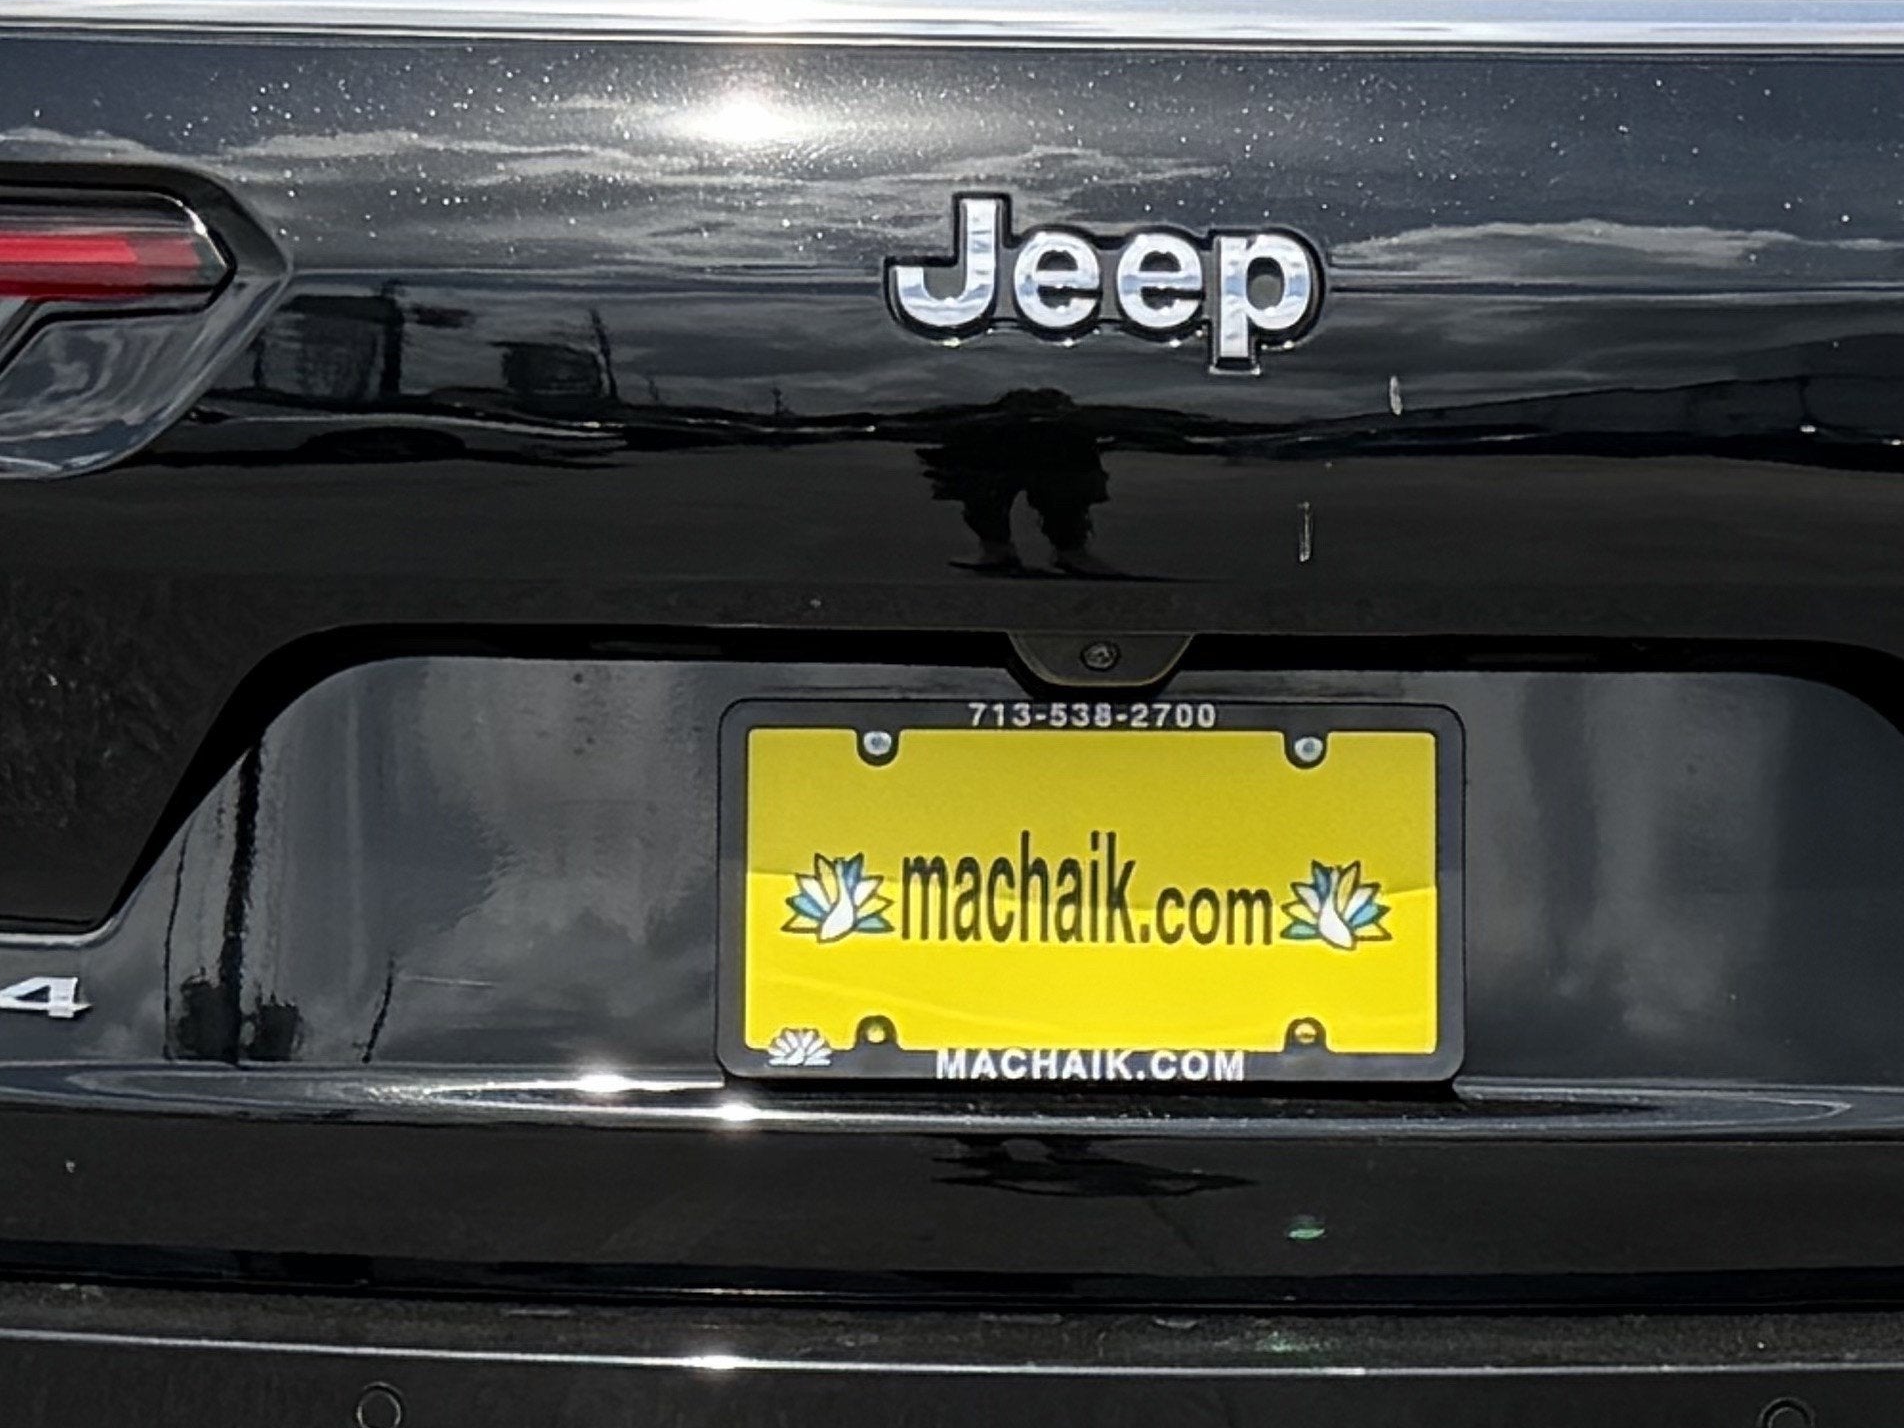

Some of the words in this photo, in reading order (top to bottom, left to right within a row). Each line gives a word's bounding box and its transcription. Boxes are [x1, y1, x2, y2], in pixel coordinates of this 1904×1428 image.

[894, 196, 1313, 360] Jeep
[967, 701, 1217, 729] 713-538-2700
[900, 828, 1274, 946] machaik.com
[935, 1047, 1246, 1082] MACHAIK.COM
